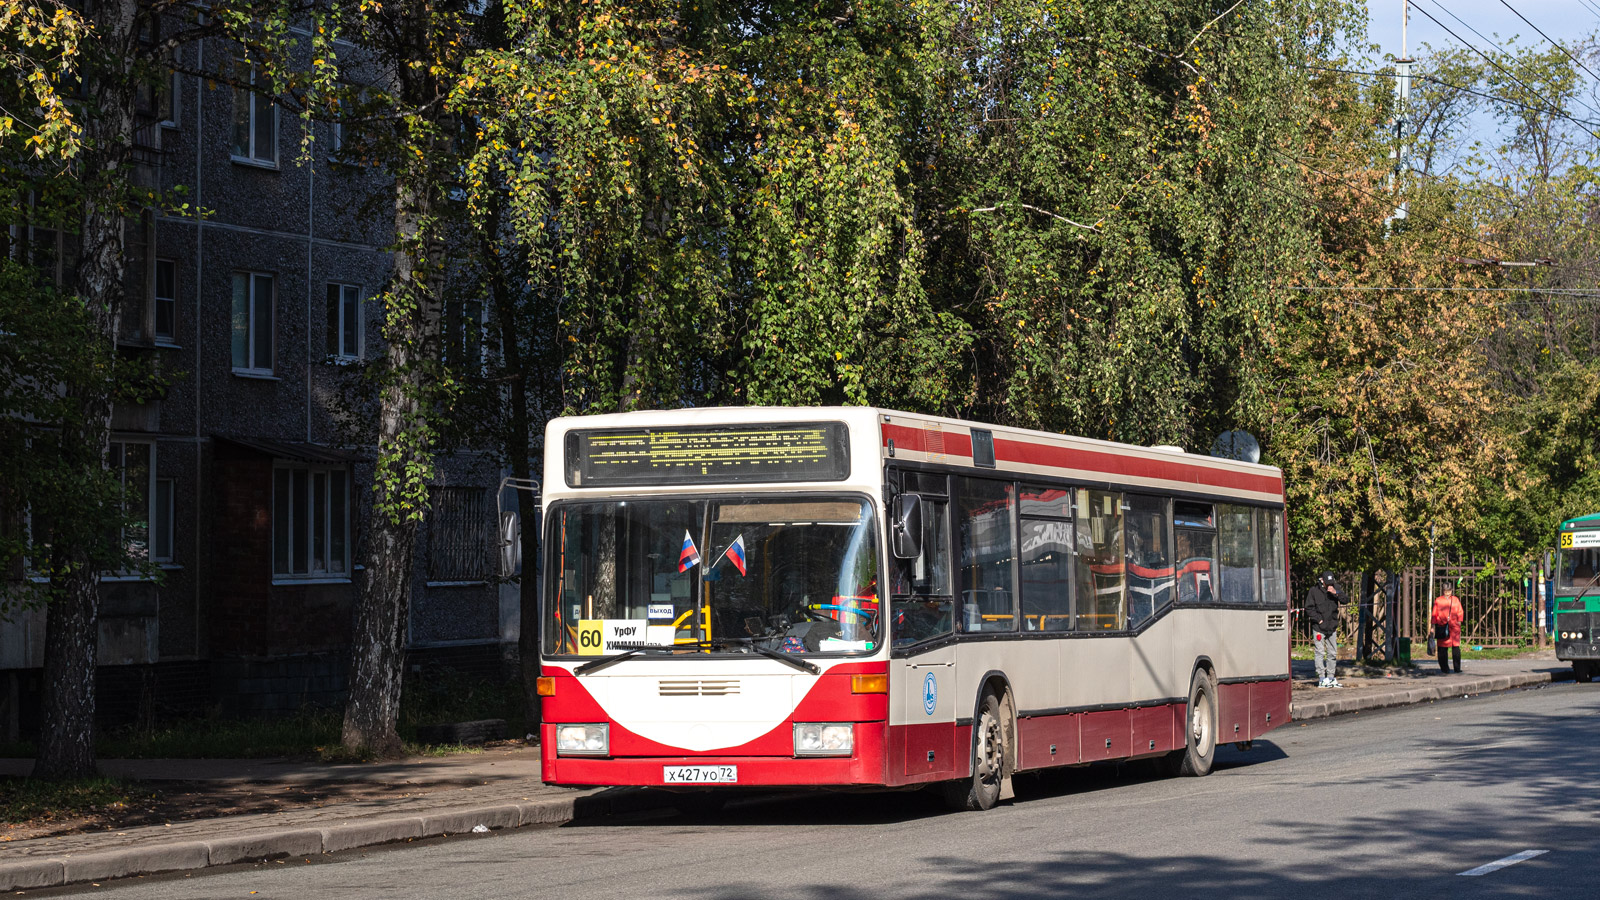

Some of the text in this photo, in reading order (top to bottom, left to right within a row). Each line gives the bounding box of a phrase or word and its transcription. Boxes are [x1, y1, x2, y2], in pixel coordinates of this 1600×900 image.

[1561, 534, 1573, 546] 55
[614, 626, 636, 637] УрФУ
[580, 629, 602, 648] 60
[720, 767, 733, 778] 72
